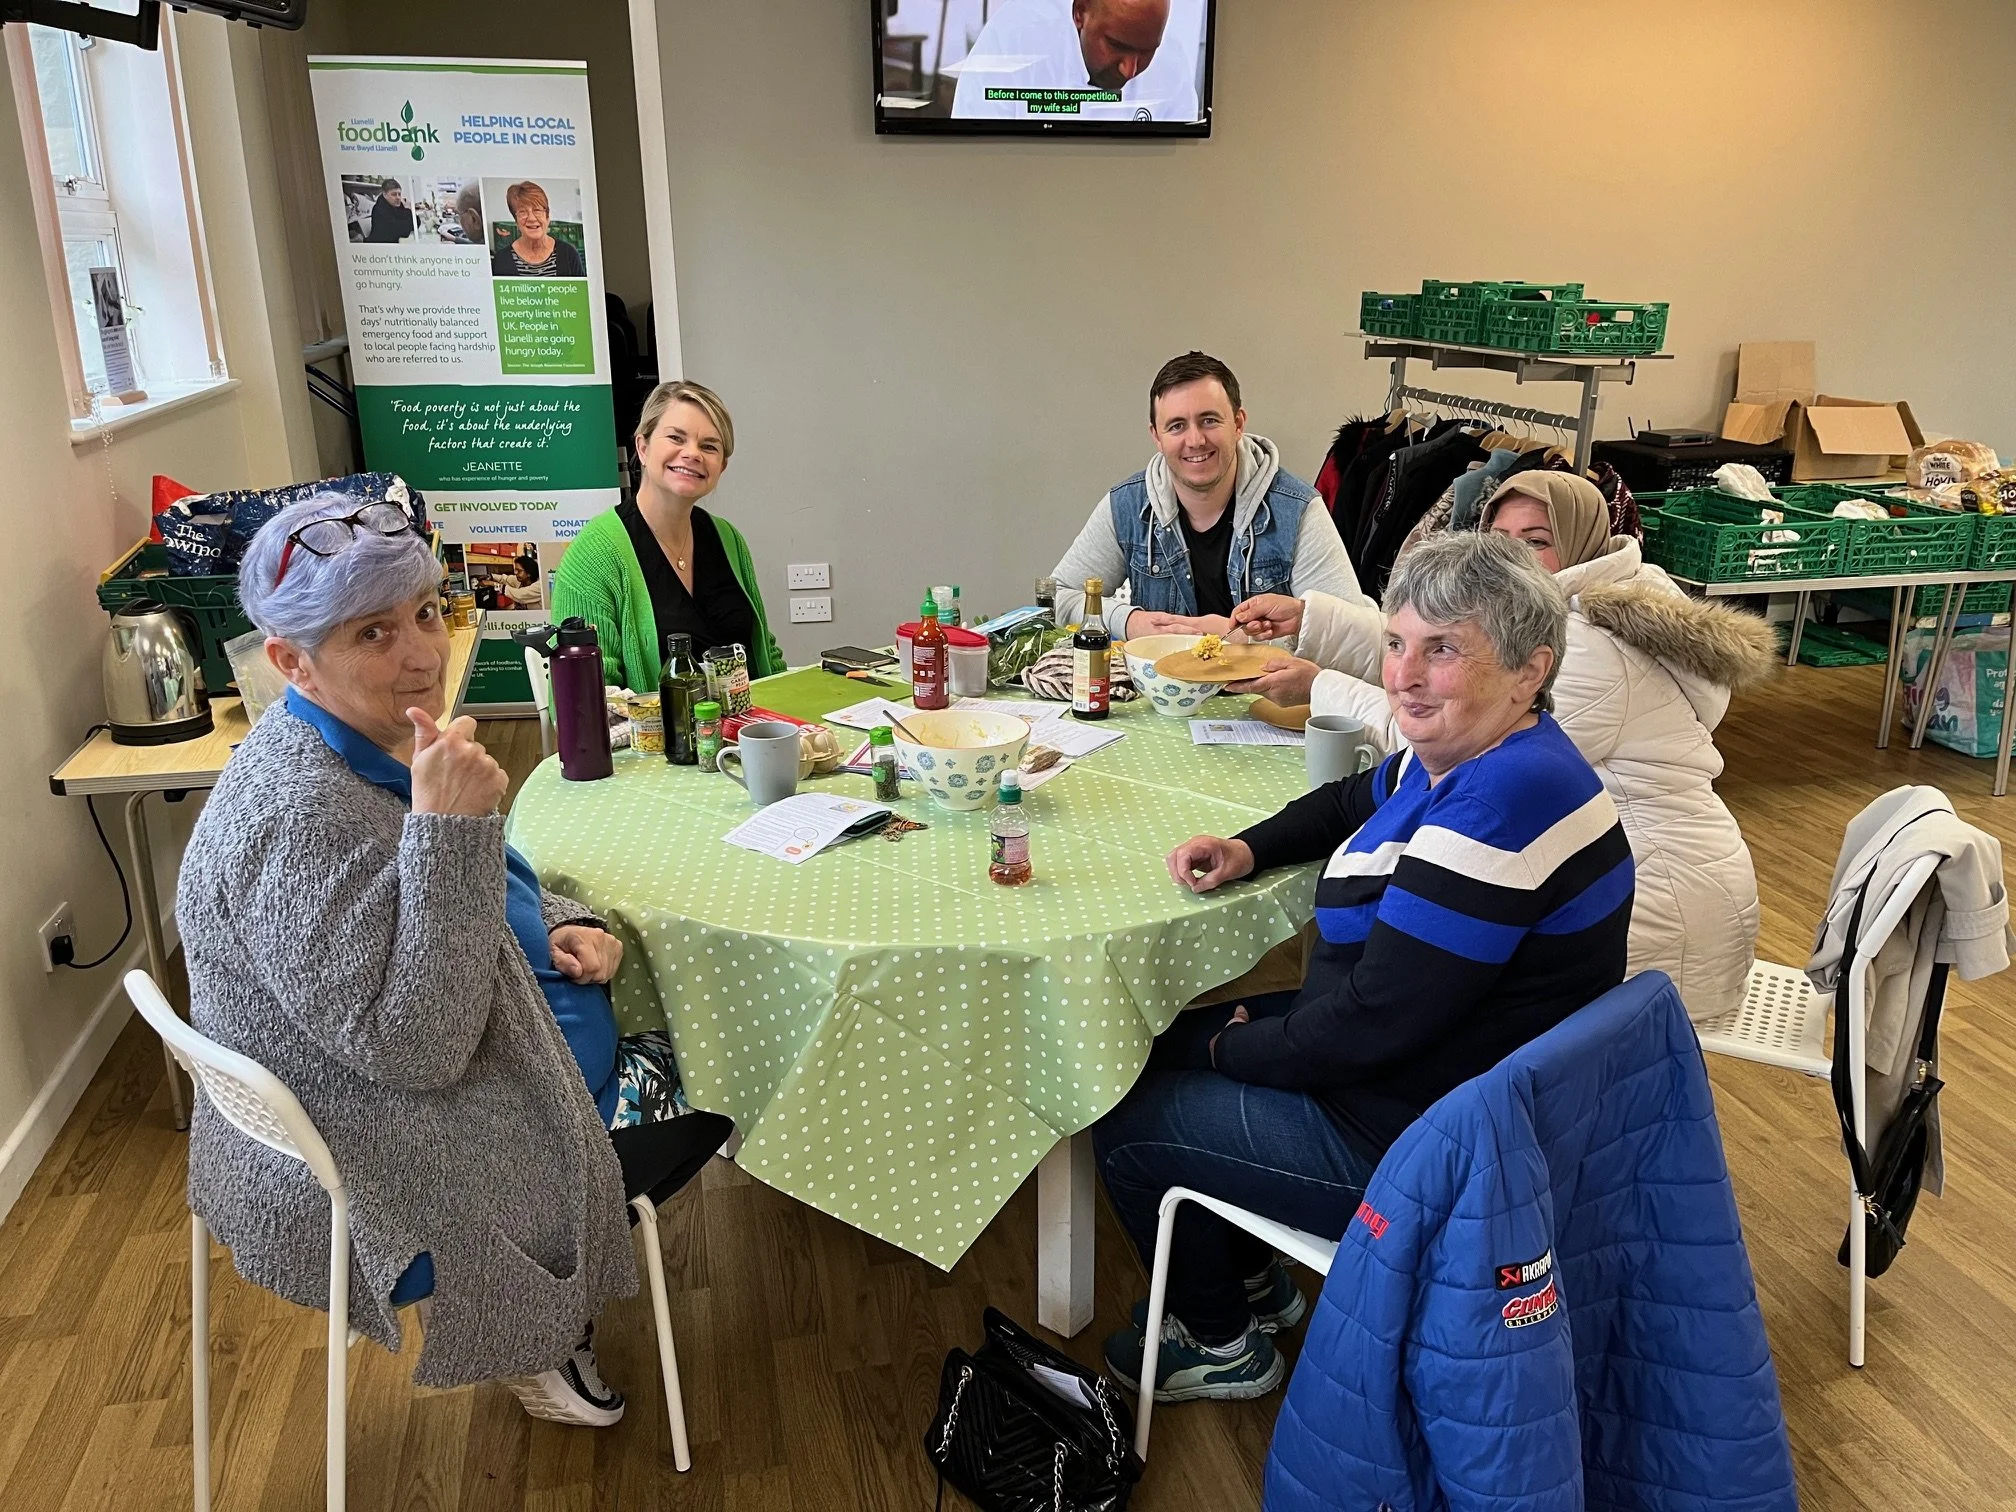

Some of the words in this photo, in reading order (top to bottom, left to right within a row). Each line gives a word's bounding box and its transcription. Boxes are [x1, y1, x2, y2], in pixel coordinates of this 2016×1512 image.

[988, 90, 1014, 99] Before
[1044, 91, 1052, 99] to
[1054, 91, 1069, 100] this
[1070, 92, 1120, 102] competition,
[1030, 104, 1042, 113] my
[1044, 103, 1060, 112] wife
[1061, 103, 1078, 112] said
[461, 115, 524, 128] HELPING
[527, 117, 575, 129] LOCAL
[337, 121, 440, 143] foodbank
[454, 132, 509, 144] PEOPLE
[513, 133, 527, 144] IN
[530, 133, 576, 146] CRISIS
[352, 254, 367, 263] We
[395, 255, 418, 264] think
[420, 256, 452, 266] anyone
[455, 256, 463, 264] in
[465, 257, 480, 265] our
[353, 268, 404, 278] community
[406, 268, 436, 277] should
[438, 268, 459, 277] have
[461, 269, 470, 277] to
[355, 281, 367, 291] go
[369, 280, 402, 291] hungry.
[499, 284, 510, 294] 14
[547, 284, 578, 295] people
[500, 296, 515, 306] live
[516, 296, 543, 306] below
[544, 297, 559, 306] the
[386, 305, 404, 315] why
[422, 305, 455, 315] provide
[457, 305, 481, 315] three
[501, 310, 534, 320] poverty
[535, 309, 551, 318] line
[552, 310, 561, 318] in
[562, 309, 577, 318] the
[384, 317, 438, 328] nutritionally
[440, 317, 479, 327] balanced
[502, 321, 518, 330] UK.
[519, 321, 548, 332] People
[549, 322, 559, 330] in
[362, 331, 411, 341] emergency
[412, 330, 433, 339] food
[435, 330, 451, 339] and
[454, 331, 488, 341] support
[504, 333, 533, 343] Llanelli
[534, 335, 548, 343] are
[549, 334, 575, 345] going
[364, 343, 373, 351] to
[374, 342, 395, 351] local
[397, 342, 428, 352] people
[429, 342, 456, 352] facing
[458, 342, 496, 352] hardship
[505, 347, 536, 357] hungry
[537, 347, 564, 357] today.
[365, 354, 385, 363] who
[402, 354, 438, 363] referred
[425, 401, 466, 419] poverty
[470, 402, 479, 412] is
[484, 400, 501, 412] not
[497, 401, 526, 420] just
[529, 400, 560, 412] about
[563, 400, 581, 412] the
[402, 418, 432, 435] food,
[436, 419, 454, 431] it's
[458, 419, 489, 431] about
[493, 419, 511, 431] the
[514, 418, 573, 437] underlying
[428, 436, 467, 453] factors
[471, 437, 495, 449] that
[499, 437, 533, 449] create
[462, 461, 523, 472] JEANETTE
[1930, 462, 1951, 470] WHITE
[497, 475, 517, 483] hunger
[434, 502, 457, 512] GET
[459, 502, 518, 512] INVOLVED
[519, 502, 558, 511] TODAY
[176, 524, 207, 541] The
[469, 525, 528, 533] VOLUNTEER
[555, 530, 581, 538] MON
